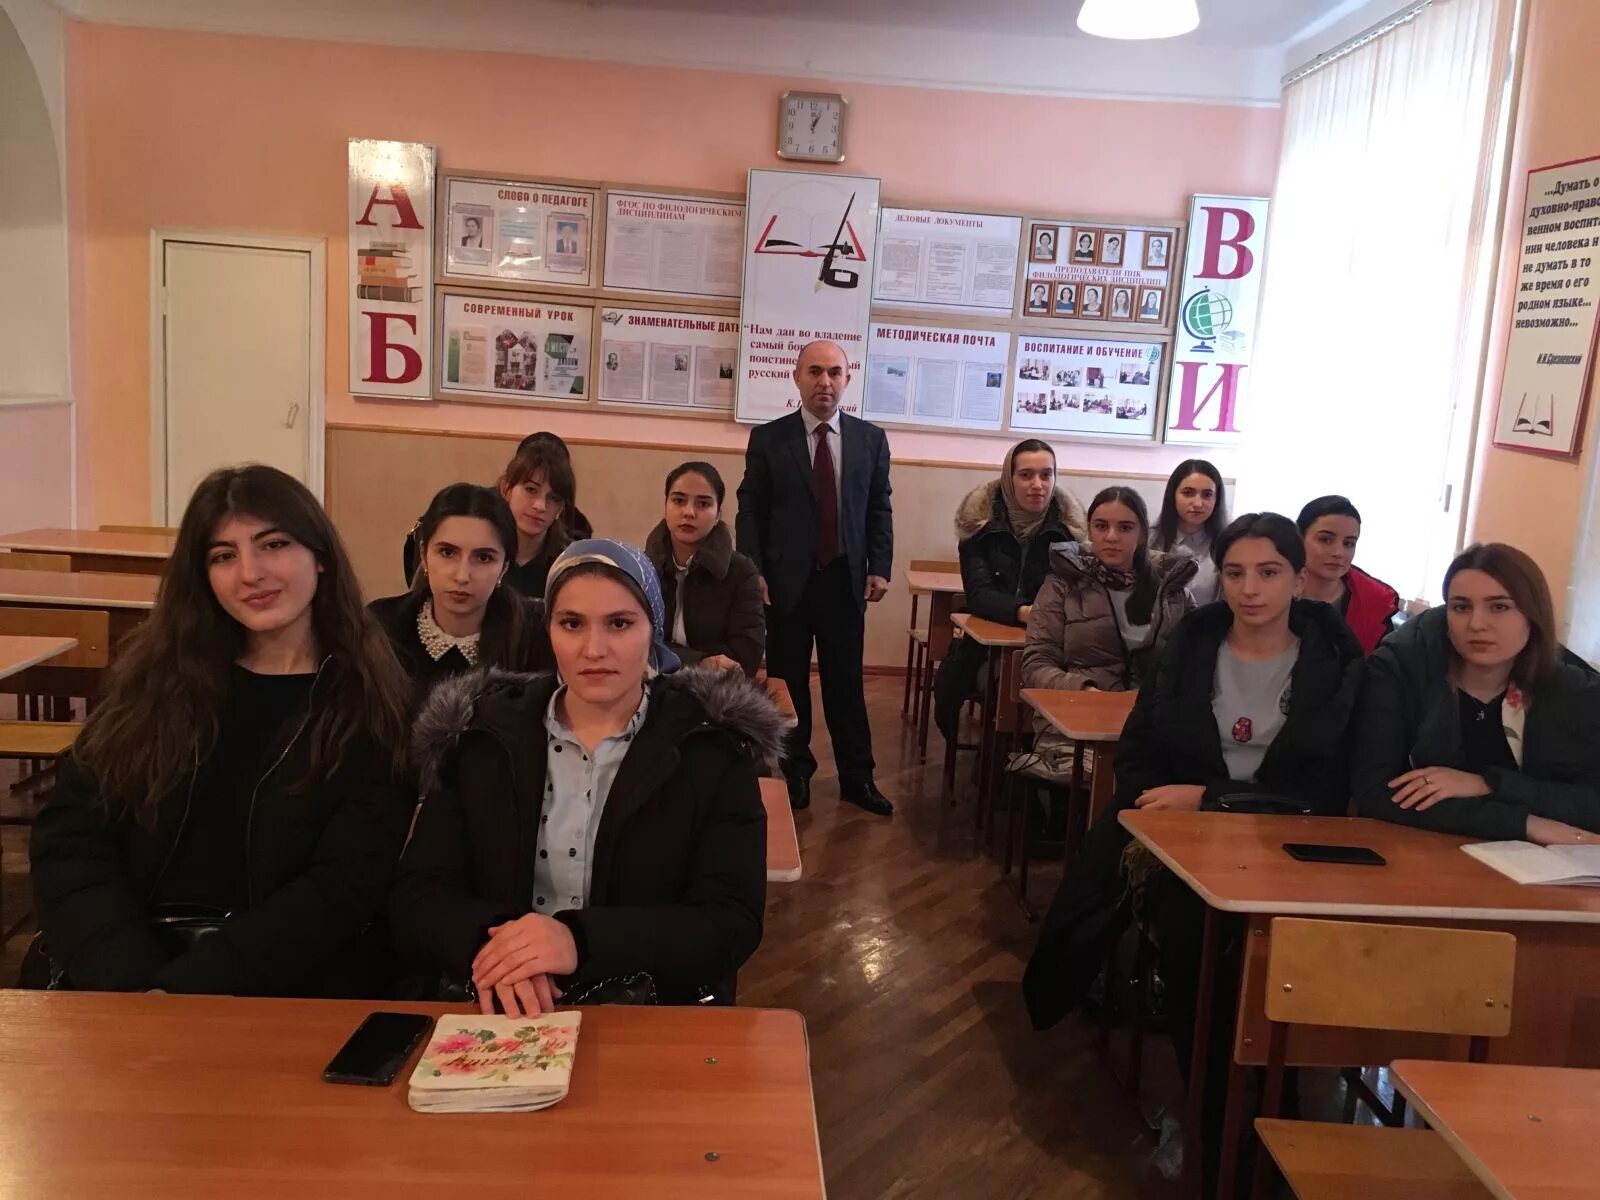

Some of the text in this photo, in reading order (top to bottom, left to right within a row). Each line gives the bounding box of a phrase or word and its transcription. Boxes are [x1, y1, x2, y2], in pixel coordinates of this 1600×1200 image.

[1593, 177, 1600, 188] о
[355, 182, 425, 230] А
[532, 192, 539, 203] О
[541, 193, 588, 208] ПЕДАГОГЕ
[616, 199, 640, 209] ФГОС
[642, 201, 656, 210] ПО
[1527, 216, 1600, 236] венном воспит
[1193, 206, 1256, 280] В
[1545, 237, 1590, 252] человека
[1522, 257, 1591, 274] не думать в то
[1520, 277, 1590, 293] же время о его
[463, 303, 574, 321] СОВРЕМЕННЫЙ УРОК
[1517, 297, 1592, 313] родном языке...
[628, 315, 716, 332] ЗНАМЕНАТЕЛЬНЫЕ
[1515, 317, 1578, 329] невозможно...
[776, 327, 795, 337] дан
[799, 329, 811, 338] во
[814, 330, 863, 342] владение
[876, 327, 996, 347] МЕТОДИЧЕСКАЯ ПОЧТА
[361, 311, 423, 384] Б
[750, 340, 784, 351] самый
[1024, 342, 1143, 359] ВОСПИТАНИЕ И ОБУЧЕНИЕ
[748, 368, 790, 379] русский
[1169, 361, 1249, 433] И
